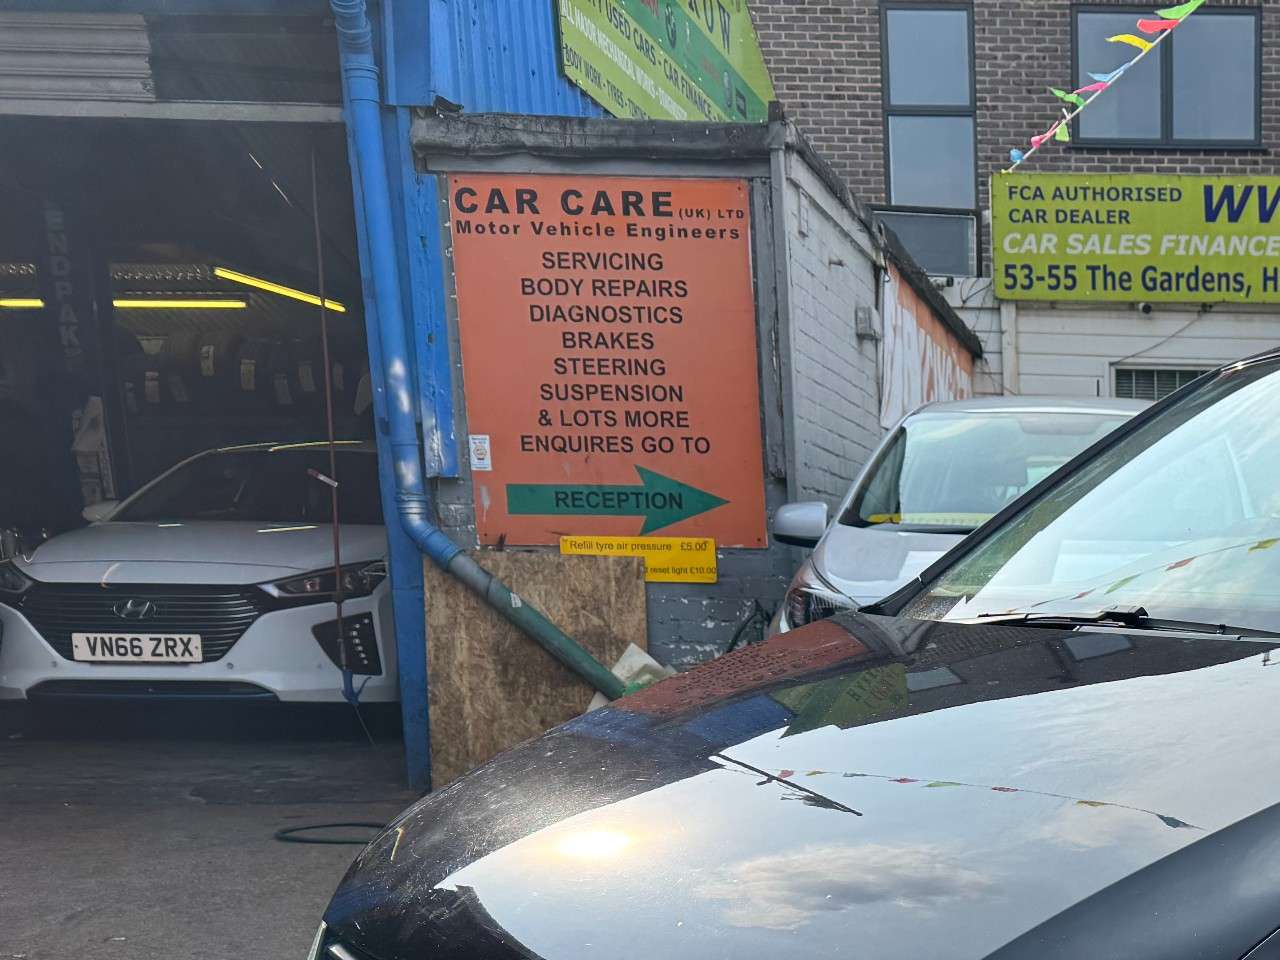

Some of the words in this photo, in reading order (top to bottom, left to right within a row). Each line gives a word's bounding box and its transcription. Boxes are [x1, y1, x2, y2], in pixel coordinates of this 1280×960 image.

[634, 28, 656, 66] CARS
[663, 58, 680, 90] CAR
[454, 187, 540, 214] CAR
[560, 189, 673, 217] CARE
[679, 209, 711, 220] (UK)
[717, 209, 744, 219] LTD
[1007, 186, 1045, 202] FCA
[1052, 186, 1183, 203] AUTHORISED
[1008, 209, 1049, 225] CAR
[1056, 209, 1131, 225] DEALER
[456, 220, 520, 234] Motor
[530, 221, 615, 236] Vehicle
[626, 223, 740, 241] Engineers
[1003, 233, 1057, 255] CAR
[1066, 234, 1151, 256] SALES
[542, 252, 664, 271] SERVICING
[521, 278, 584, 296] BODY
[592, 279, 688, 298] REPAIRS
[1003, 263, 1078, 291] 53-55
[1086, 264, 1133, 291] The
[1140, 265, 1252, 298] Gardens,
[529, 304, 683, 324] DIAGNOSTICS
[562, 331, 654, 350] BRAKES
[554, 357, 666, 376] STEERING
[540, 383, 683, 402] SUSPENSION
[538, 409, 552, 427] &
[560, 410, 617, 427] LOTS
[625, 411, 689, 428] MORE
[520, 435, 634, 453] ENQUIRES
[641, 436, 674, 453] GO
[681, 436, 710, 454] TO
[554, 491, 683, 510] RECEPTION
[570, 540, 593, 550] Refill
[596, 541, 614, 552] tyre
[631, 543, 672, 553] pressure
[671, 567, 688, 576] light
[85, 637, 143, 658] VN66
[149, 637, 194, 658] ZRX
